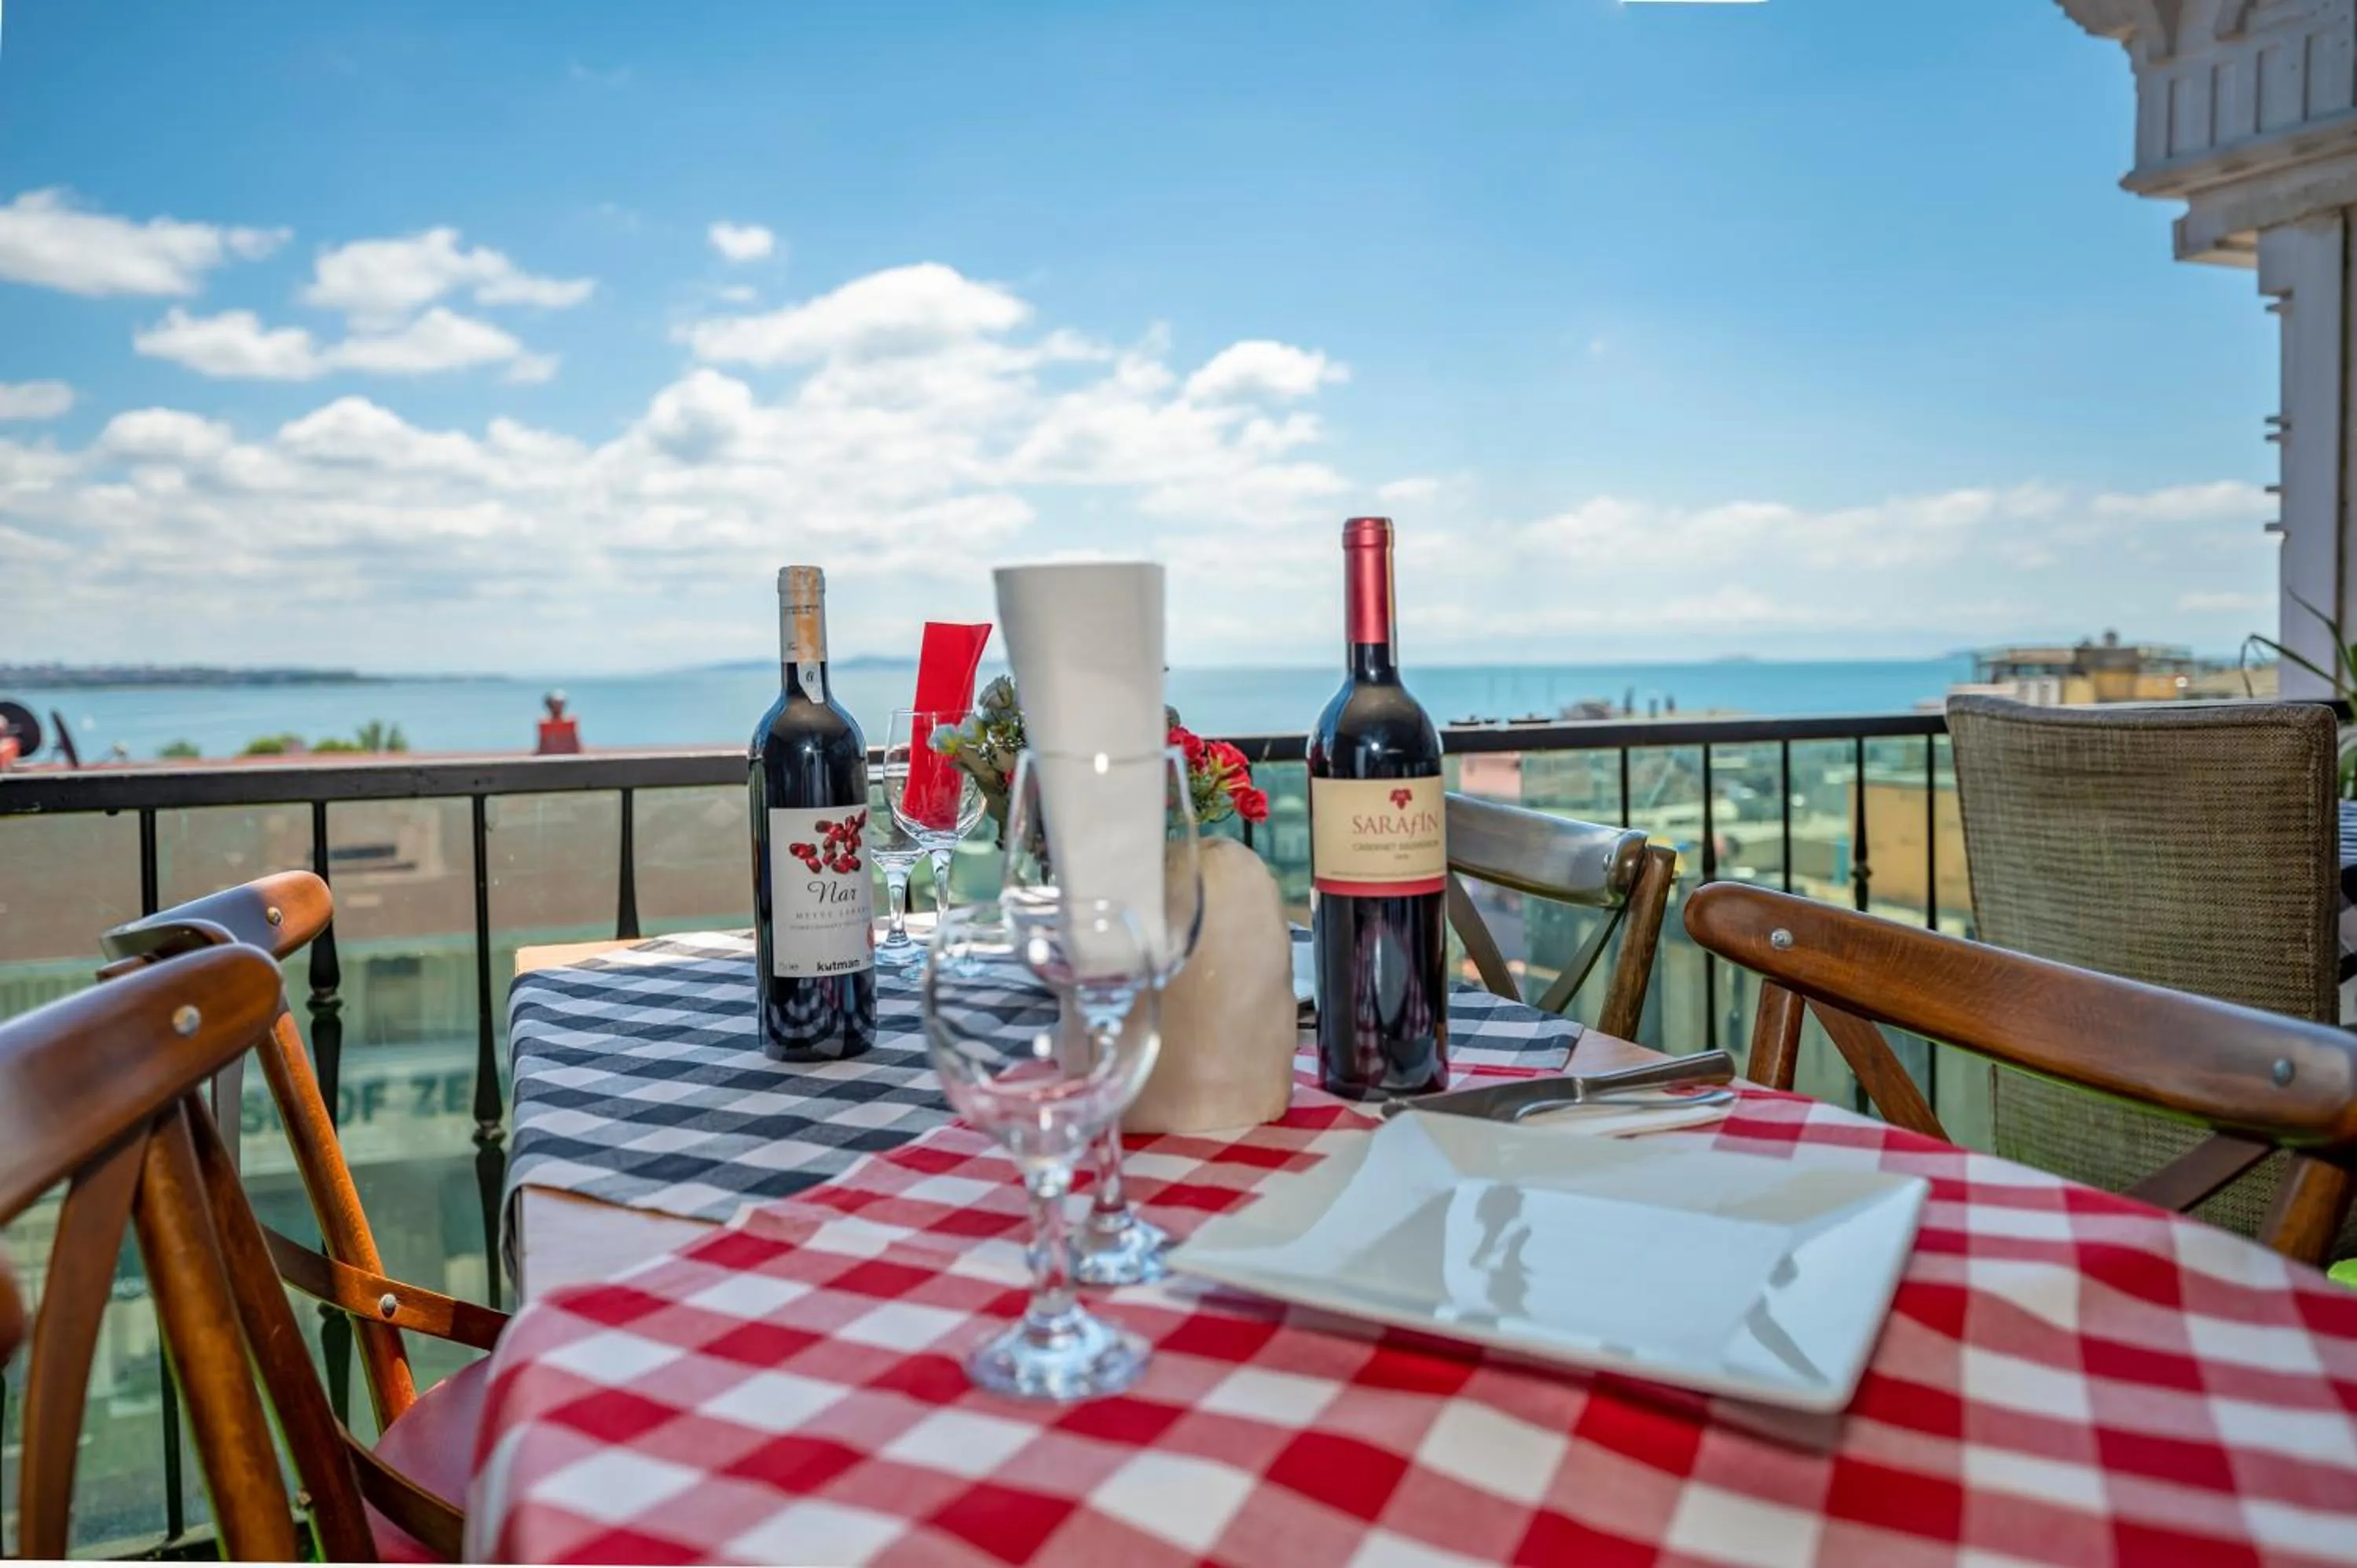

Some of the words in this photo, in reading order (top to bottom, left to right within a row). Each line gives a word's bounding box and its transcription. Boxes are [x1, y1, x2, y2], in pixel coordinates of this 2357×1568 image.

[807, 881, 856, 903] Nar
[816, 959, 860, 972] kutman
[410, 1068, 473, 1118] ZE
